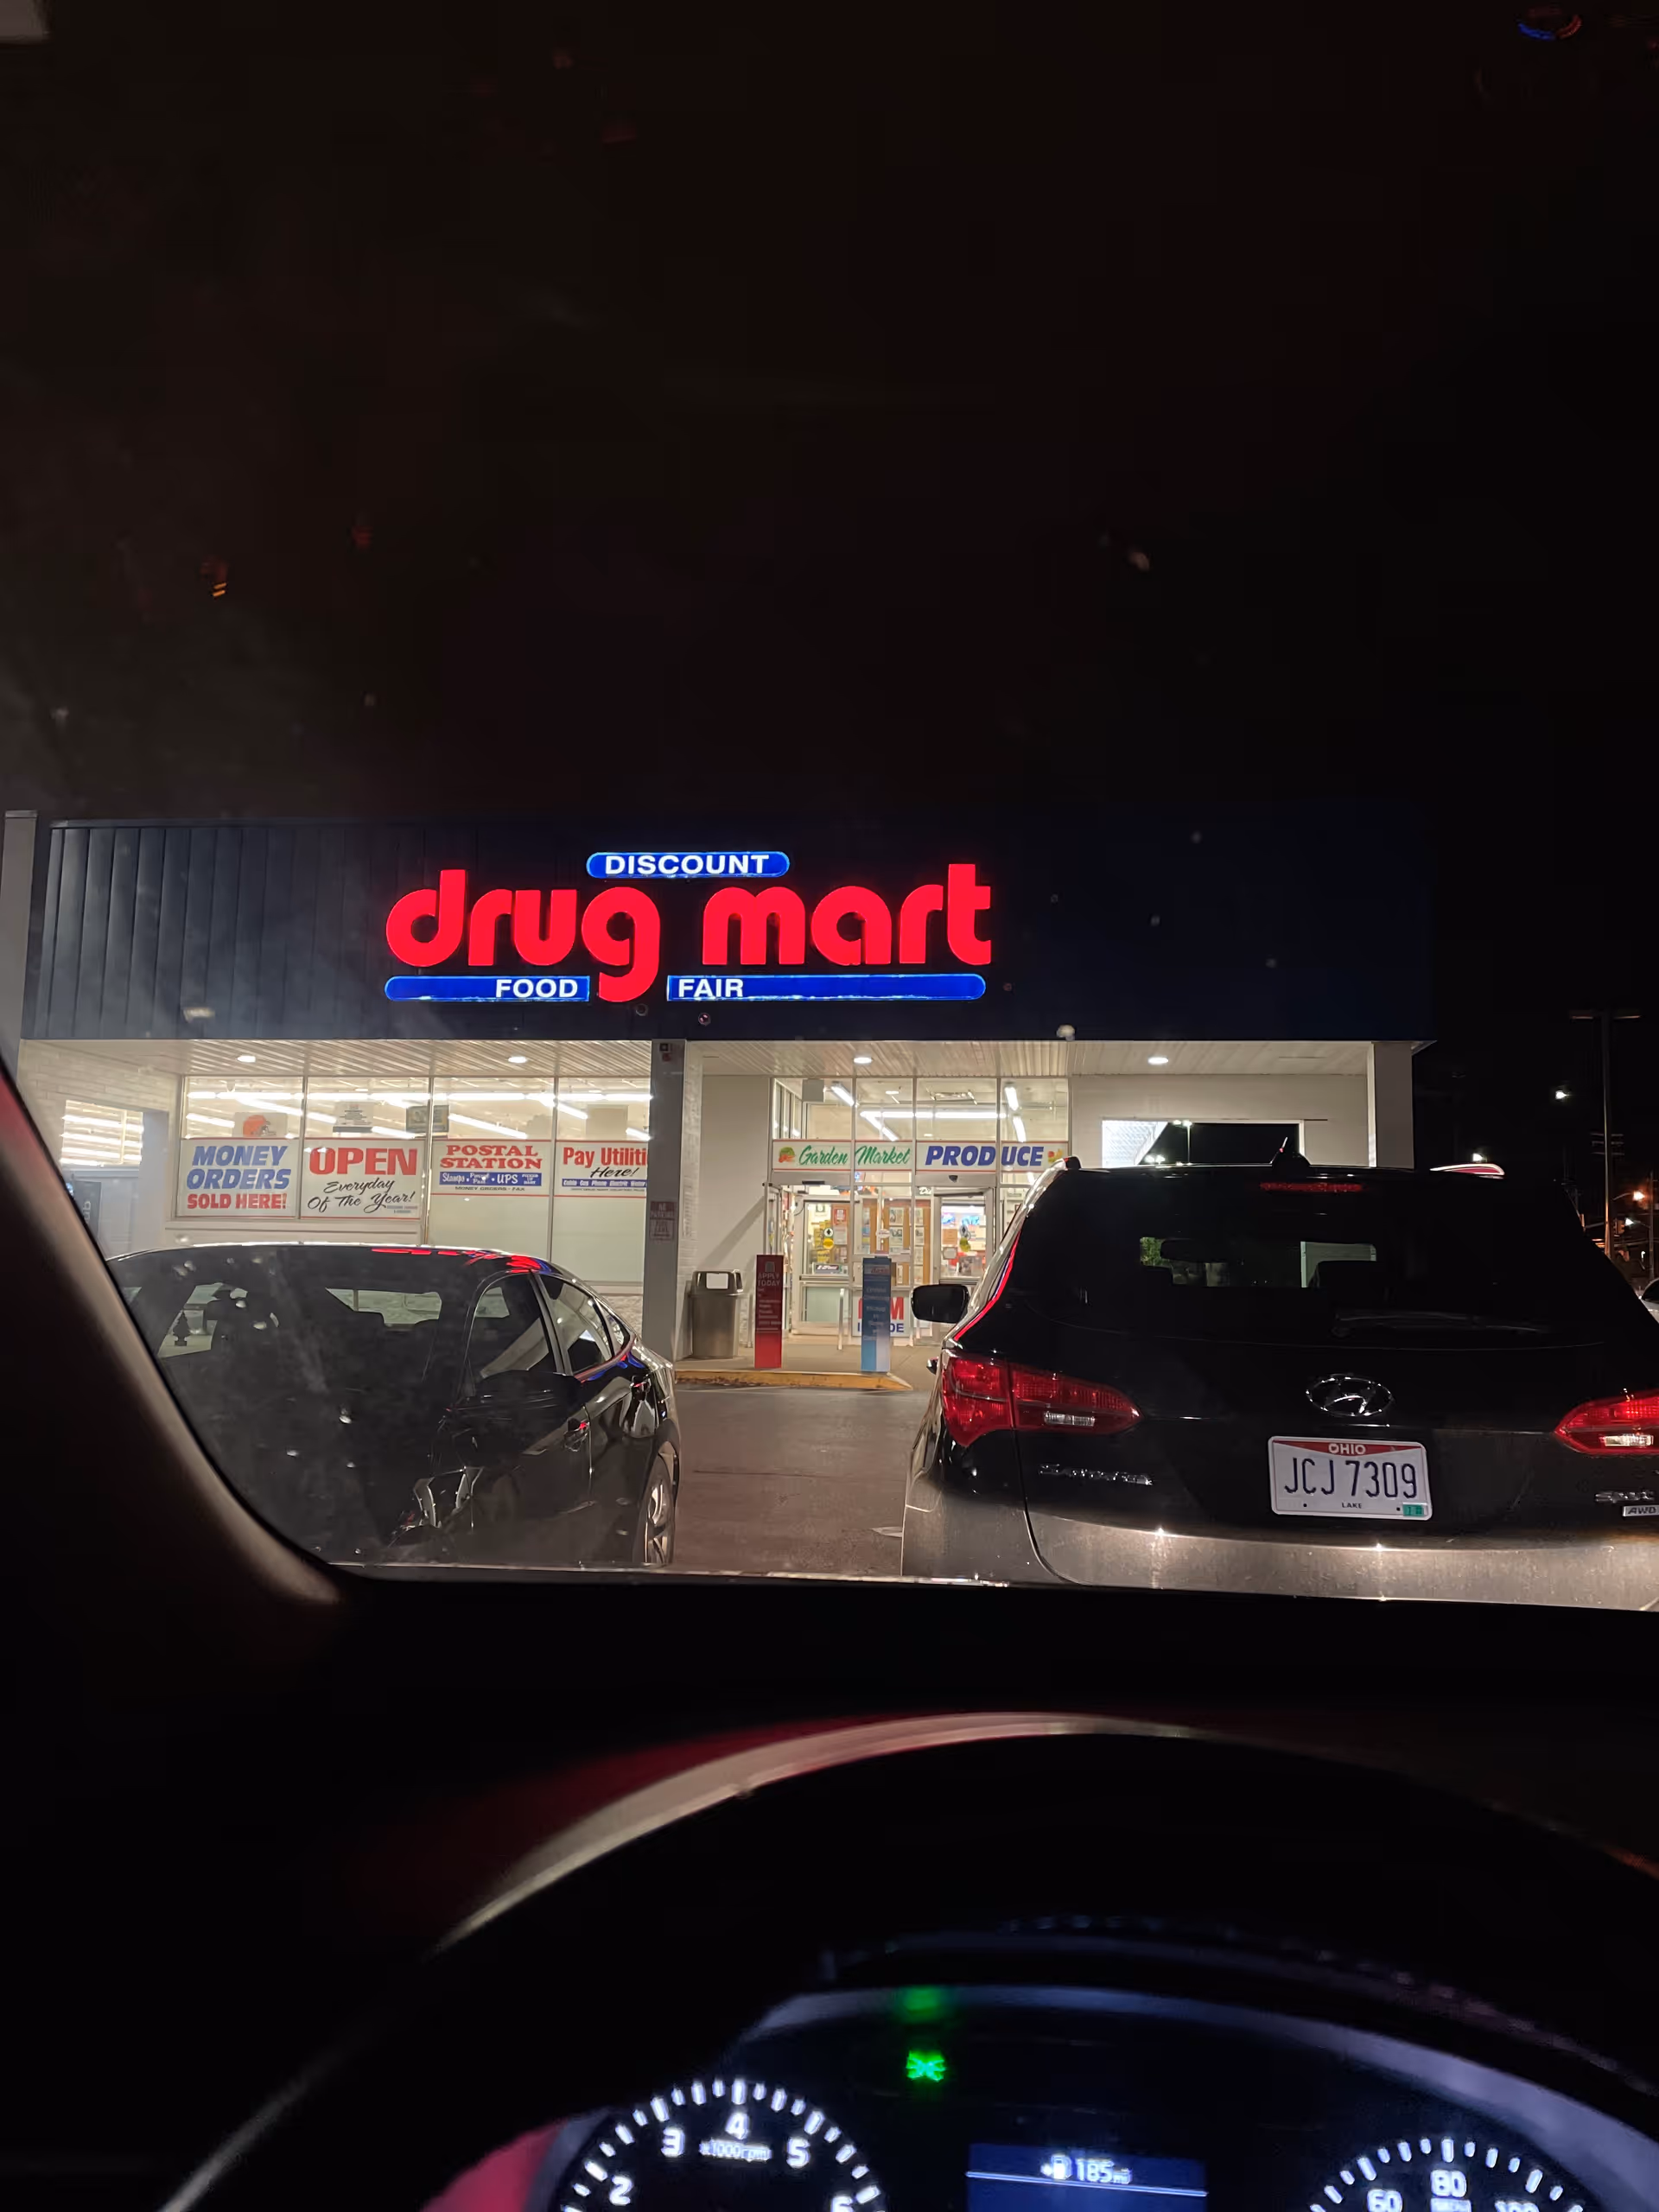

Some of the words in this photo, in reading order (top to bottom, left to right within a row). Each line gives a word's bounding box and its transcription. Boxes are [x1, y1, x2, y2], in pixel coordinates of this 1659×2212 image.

[605, 855, 769, 874] DISCOUNT
[386, 868, 661, 1002] drug
[702, 863, 992, 965] mart
[495, 978, 579, 998] FOOD
[677, 978, 745, 999] FAIR
[192, 1145, 289, 1166] MONEY
[308, 1147, 418, 1176] OPEN
[446, 1145, 538, 1157] POSTAL
[563, 1147, 595, 1168] Pay
[601, 1147, 647, 1166] Utiliti
[798, 1145, 849, 1165] Garden
[854, 1145, 912, 1166] Market
[925, 1145, 1044, 1166] PRODUCE
[440, 1158, 543, 1170] STATION
[589, 1166, 640, 1178] Here!
[187, 1168, 292, 1190] ORDERS
[322, 1177, 396, 1196] Everyday
[497, 1173, 518, 1185] UPS
[187, 1193, 232, 1210] SOLD
[235, 1192, 288, 1210] HERE!
[307, 1196, 331, 1213] Of
[334, 1194, 361, 1208] The
[363, 1191, 416, 1214] Year!
[1328, 1443, 1366, 1455] OHIO
[1284, 1458, 1335, 1495] JCJ
[1344, 1459, 1418, 1499] 7309
[1627, 1506, 1656, 1515] AWD
[725, 2112, 750, 2140] 4
[660, 2126, 685, 2158] 3
[786, 2137, 810, 2169] 5
[608, 2175, 633, 2206] 2
[1430, 2169, 1467, 2197] 80
